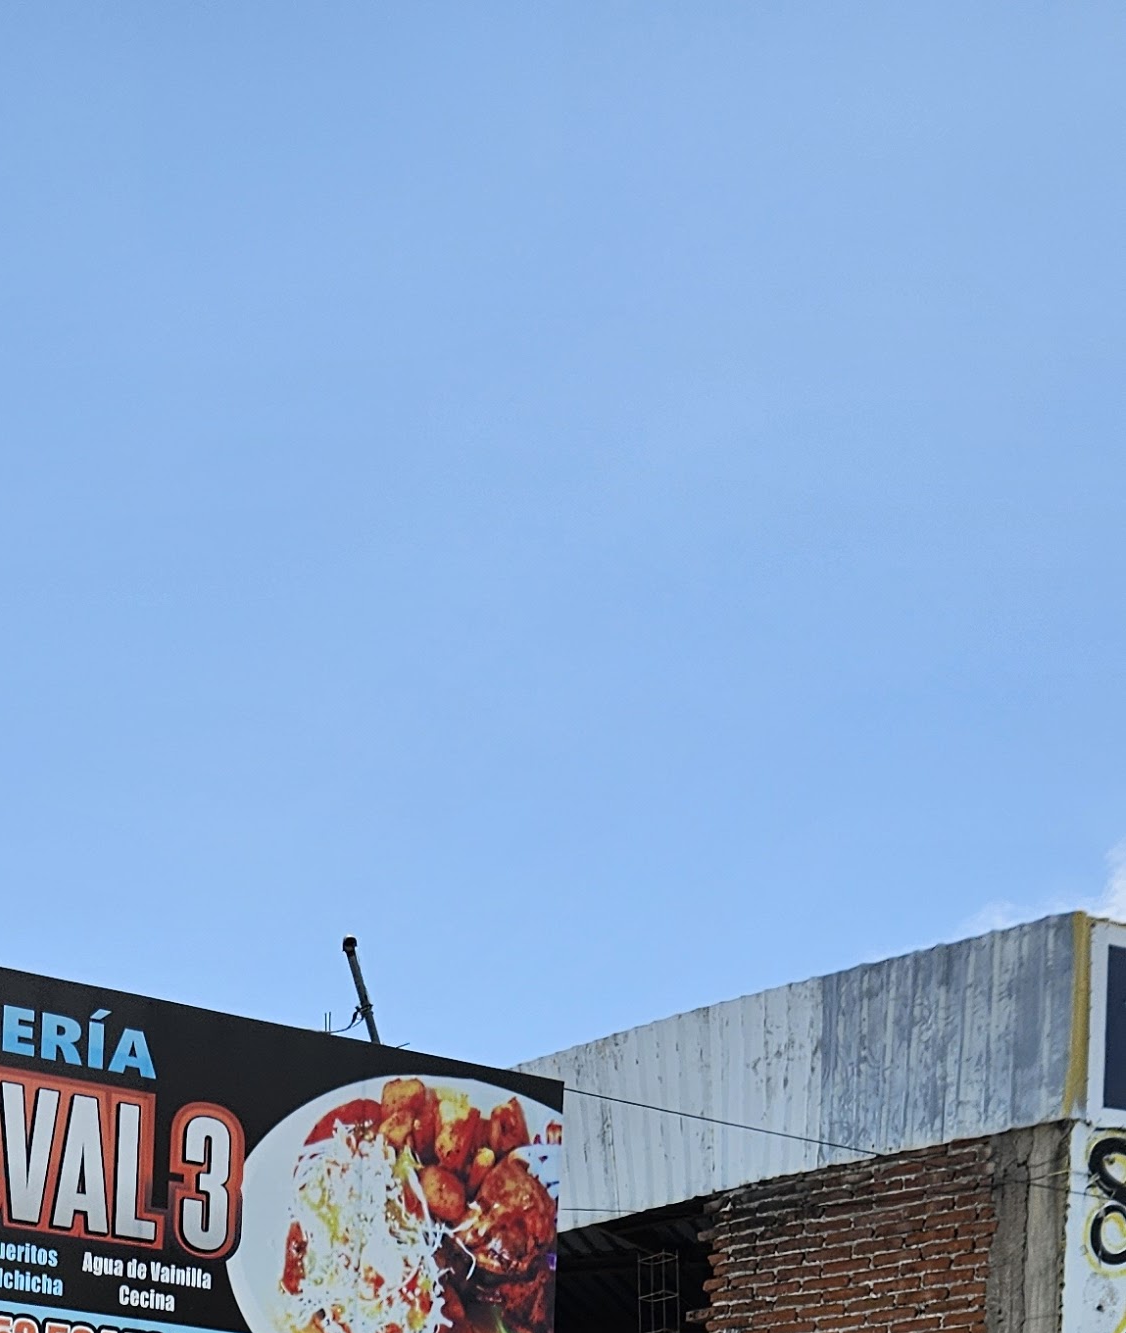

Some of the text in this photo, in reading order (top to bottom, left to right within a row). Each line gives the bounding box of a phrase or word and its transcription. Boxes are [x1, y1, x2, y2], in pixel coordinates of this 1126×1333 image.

[177, 1110, 237, 1256] 3
[82, 1251, 213, 1290] Agua de Vainilla
[118, 1285, 176, 1312] Cecina
